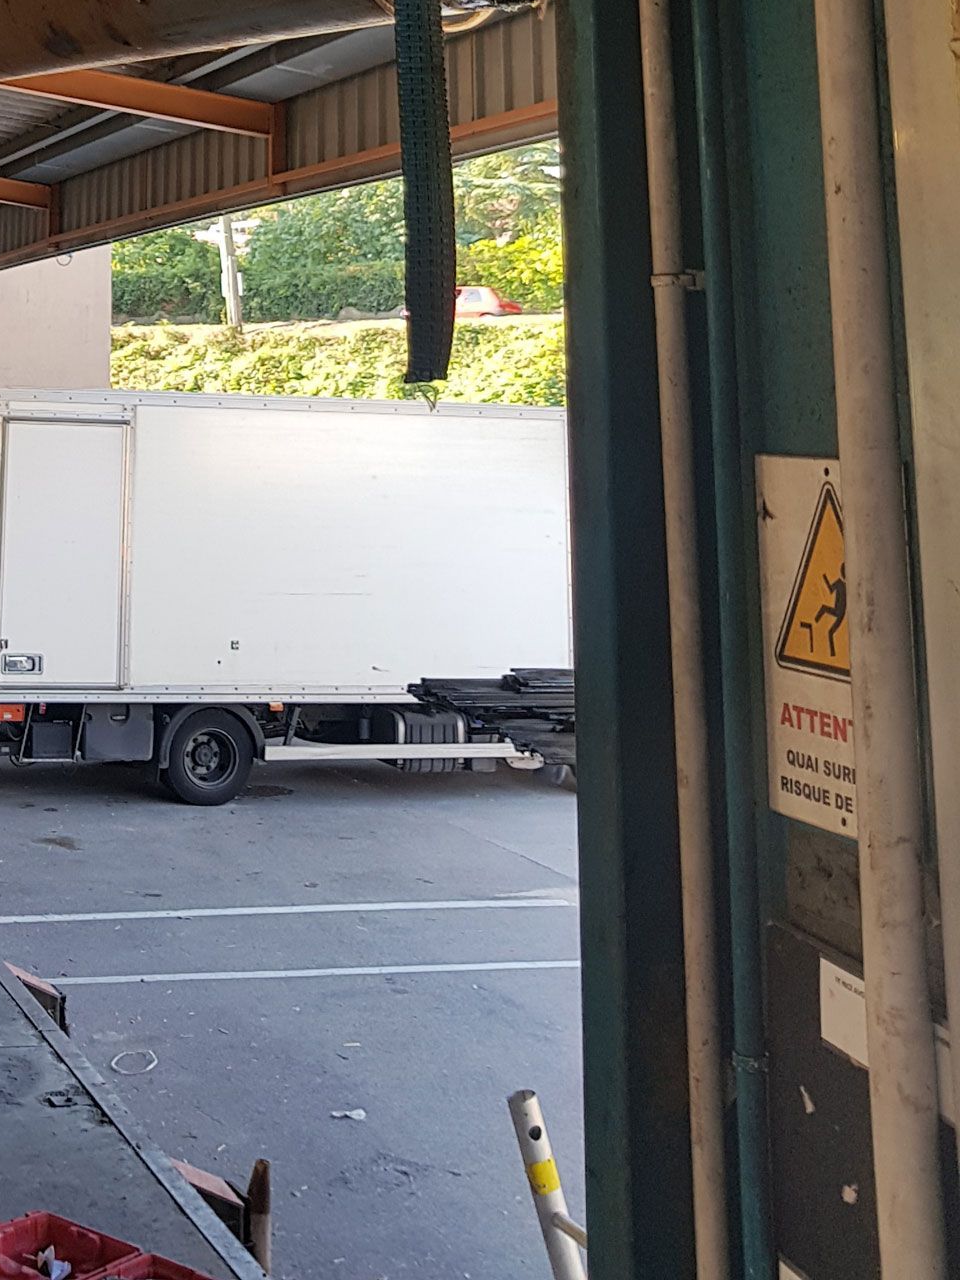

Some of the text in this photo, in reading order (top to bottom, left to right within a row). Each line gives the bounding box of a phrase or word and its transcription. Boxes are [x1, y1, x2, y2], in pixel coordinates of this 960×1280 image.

[786, 749, 819, 773] QUAI
[781, 775, 854, 814] RISQUE DE
